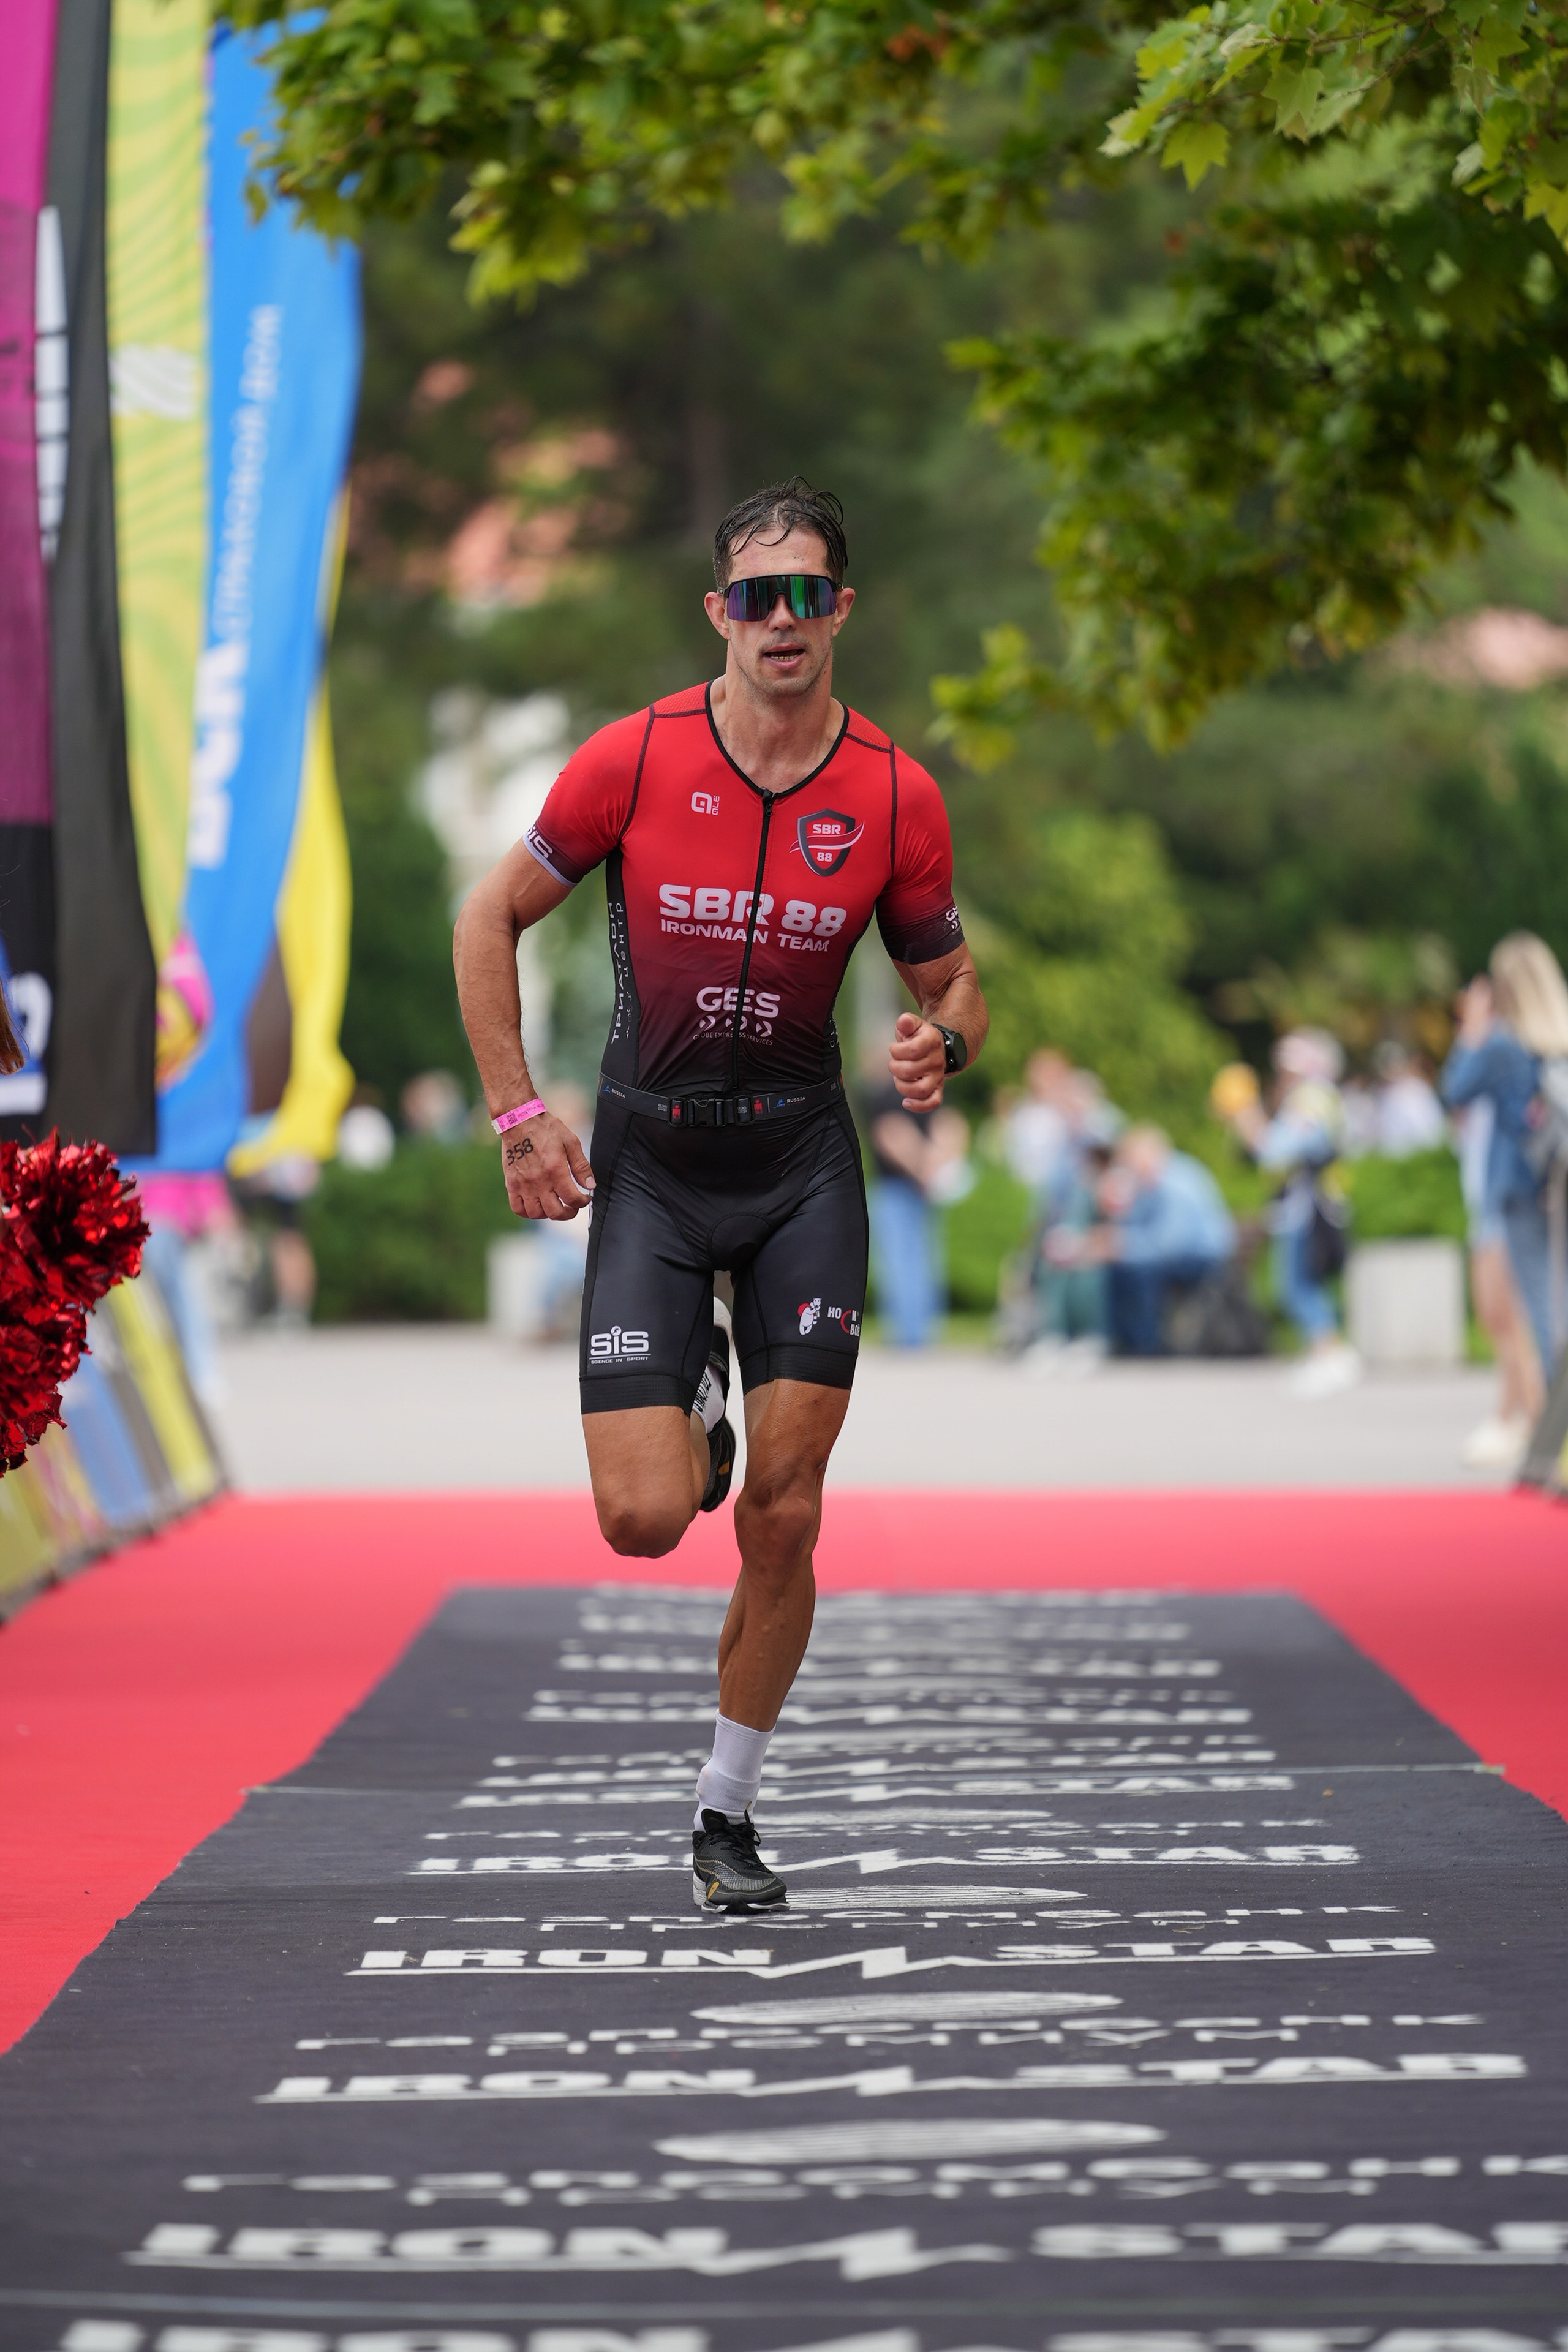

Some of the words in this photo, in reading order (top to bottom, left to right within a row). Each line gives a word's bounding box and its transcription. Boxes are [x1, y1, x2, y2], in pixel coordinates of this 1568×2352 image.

[812, 824, 841, 834] SBR
[816, 852, 832, 862] 88
[659, 884, 774, 925] SBR
[781, 900, 847, 937] 88
[661, 919, 769, 944] IRONMAN
[777, 933, 831, 952] TEAM
[608, 902, 624, 1044] ТРИАТЛОН
[696, 987, 781, 1019] GES
[611, 1088, 626, 1098] RUSSIA
[506, 1138, 534, 1166] 358
[975, 1845, 1360, 1861] STAR
[993, 1937, 1436, 1959] STAR
